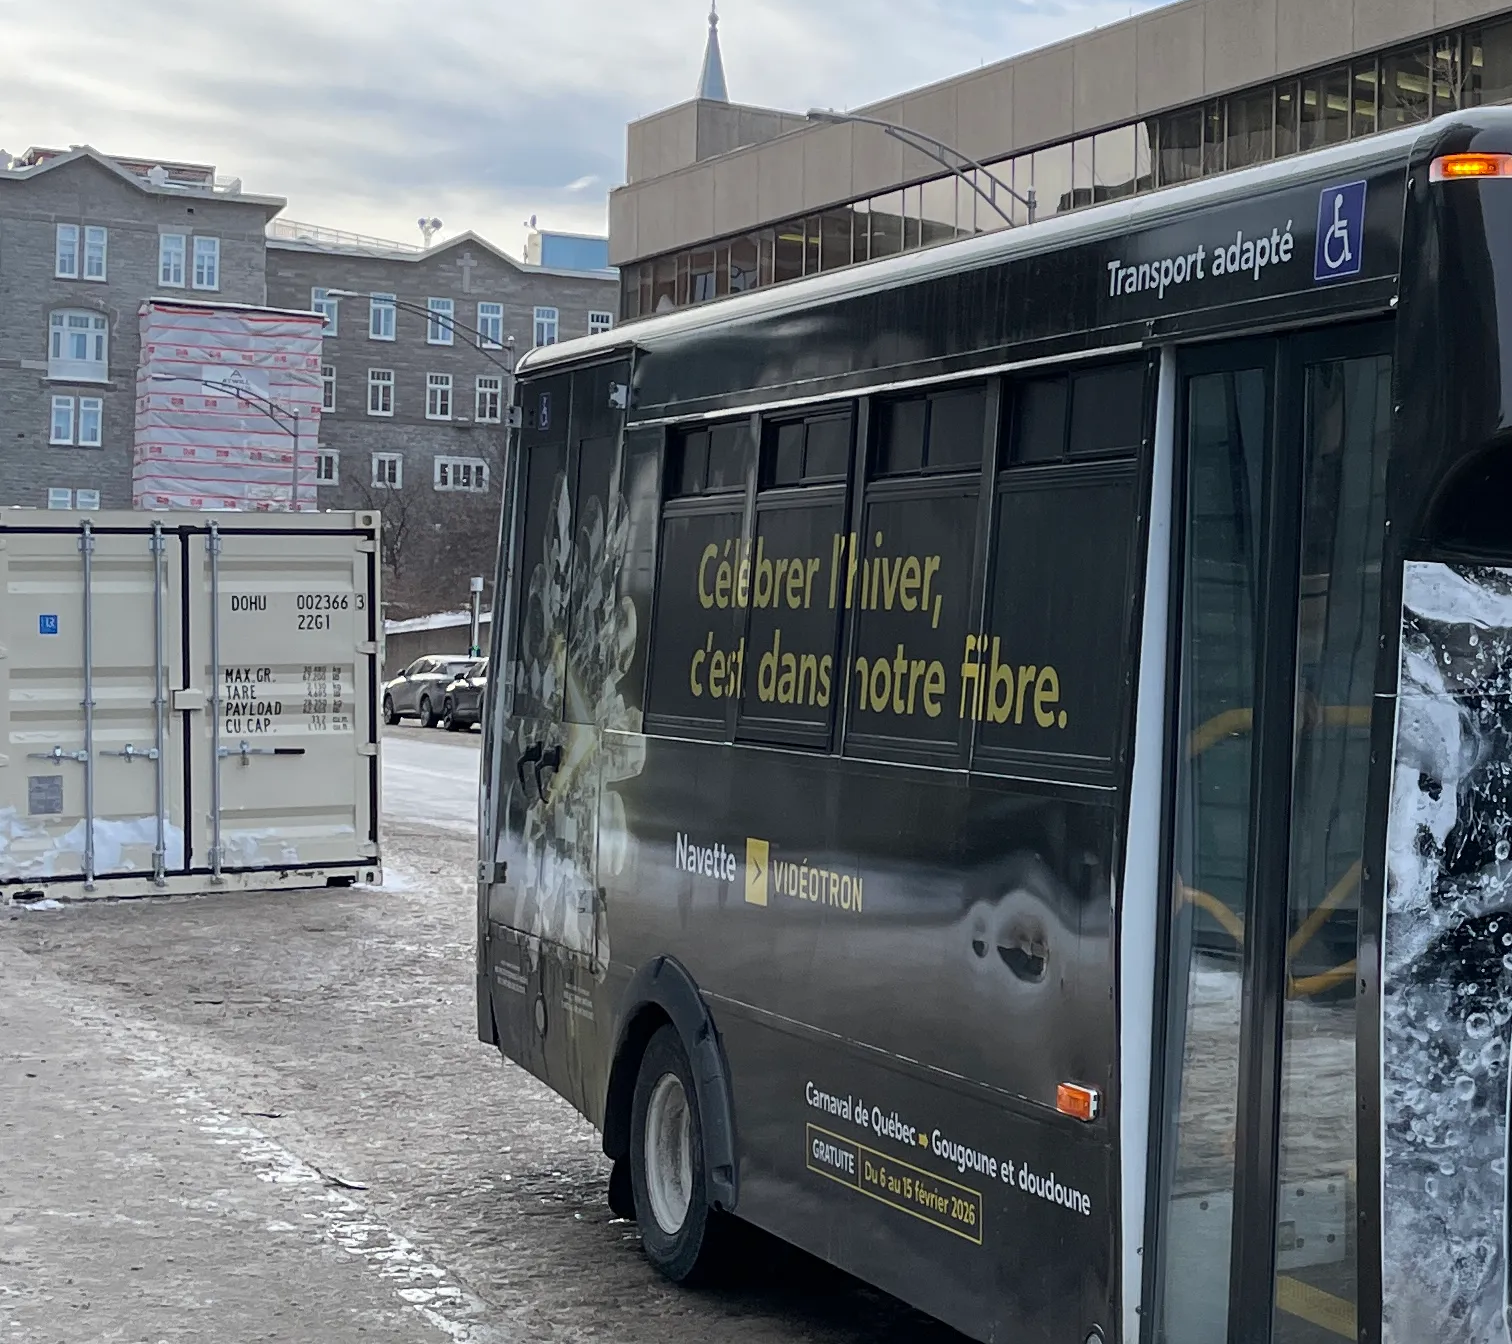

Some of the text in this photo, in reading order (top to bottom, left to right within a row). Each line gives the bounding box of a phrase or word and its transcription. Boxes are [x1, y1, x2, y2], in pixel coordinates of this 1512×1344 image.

[1107, 219, 1294, 299] Transport adapté
[231, 594, 365, 611] DOHU 002366 3
[698, 535, 820, 610] Célébrer
[298, 614, 331, 630] 22G1
[225, 701, 282, 717] PAYLOAD
[226, 685, 257, 700] TARE
[690, 629, 1068, 730] c'est dans notre fibre.
[675, 831, 864, 913] Navette VIDÉOTRON
[805, 1081, 1091, 1216] Carnaval de Québec Gougoune et doudoune
[812, 1138, 976, 1226] GRATUITE Du 6 au 15 février 2026
